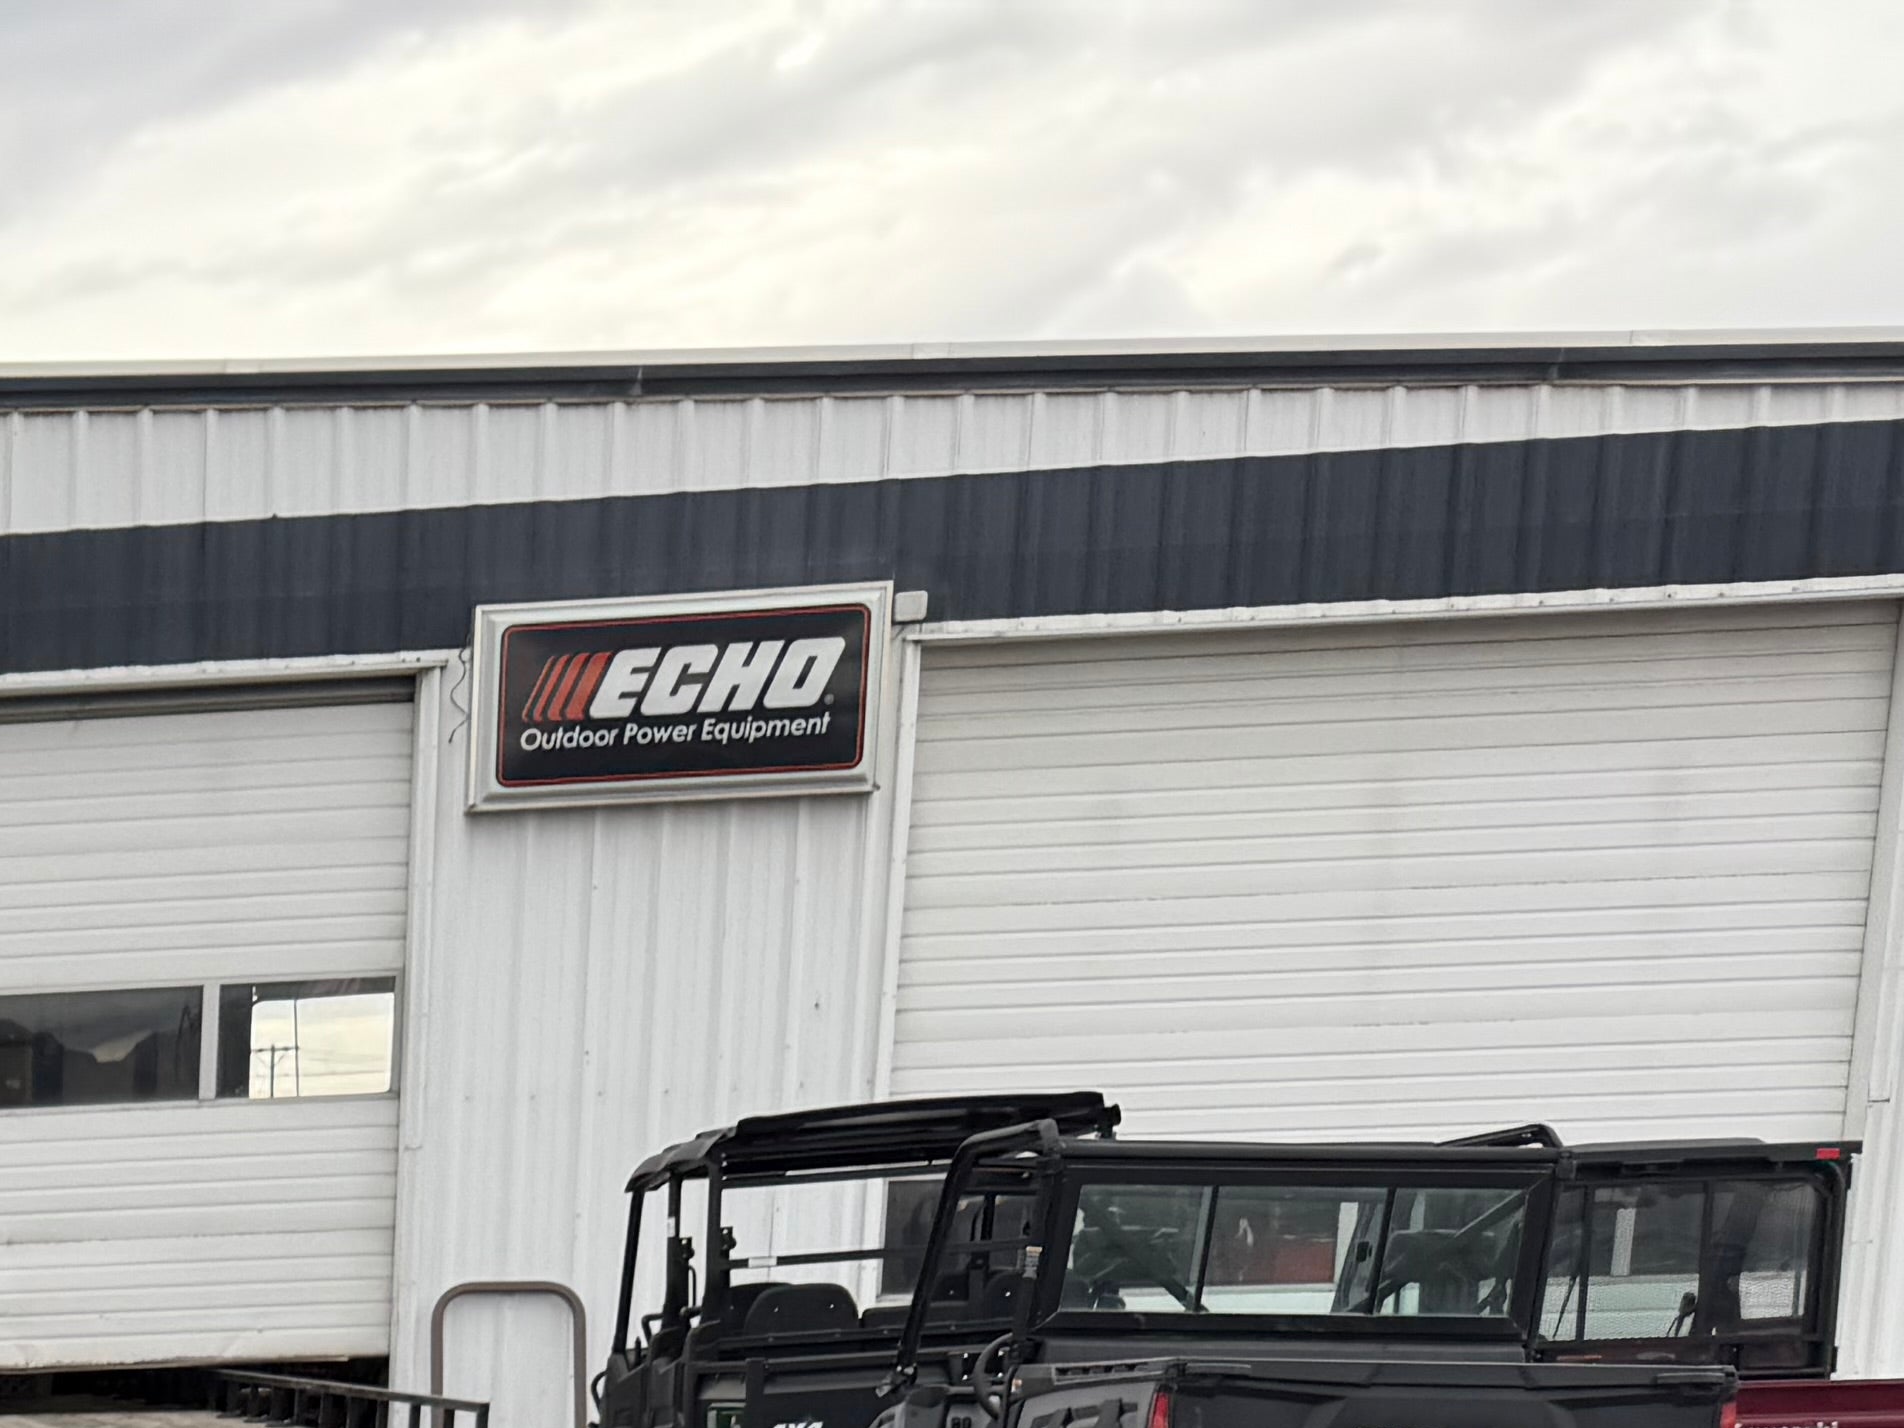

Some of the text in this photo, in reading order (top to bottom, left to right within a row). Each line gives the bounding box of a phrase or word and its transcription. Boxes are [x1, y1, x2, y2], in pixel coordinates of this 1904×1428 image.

[589, 637, 846, 719] ECHO
[520, 711, 831, 751] Outdoor Power Equipment
